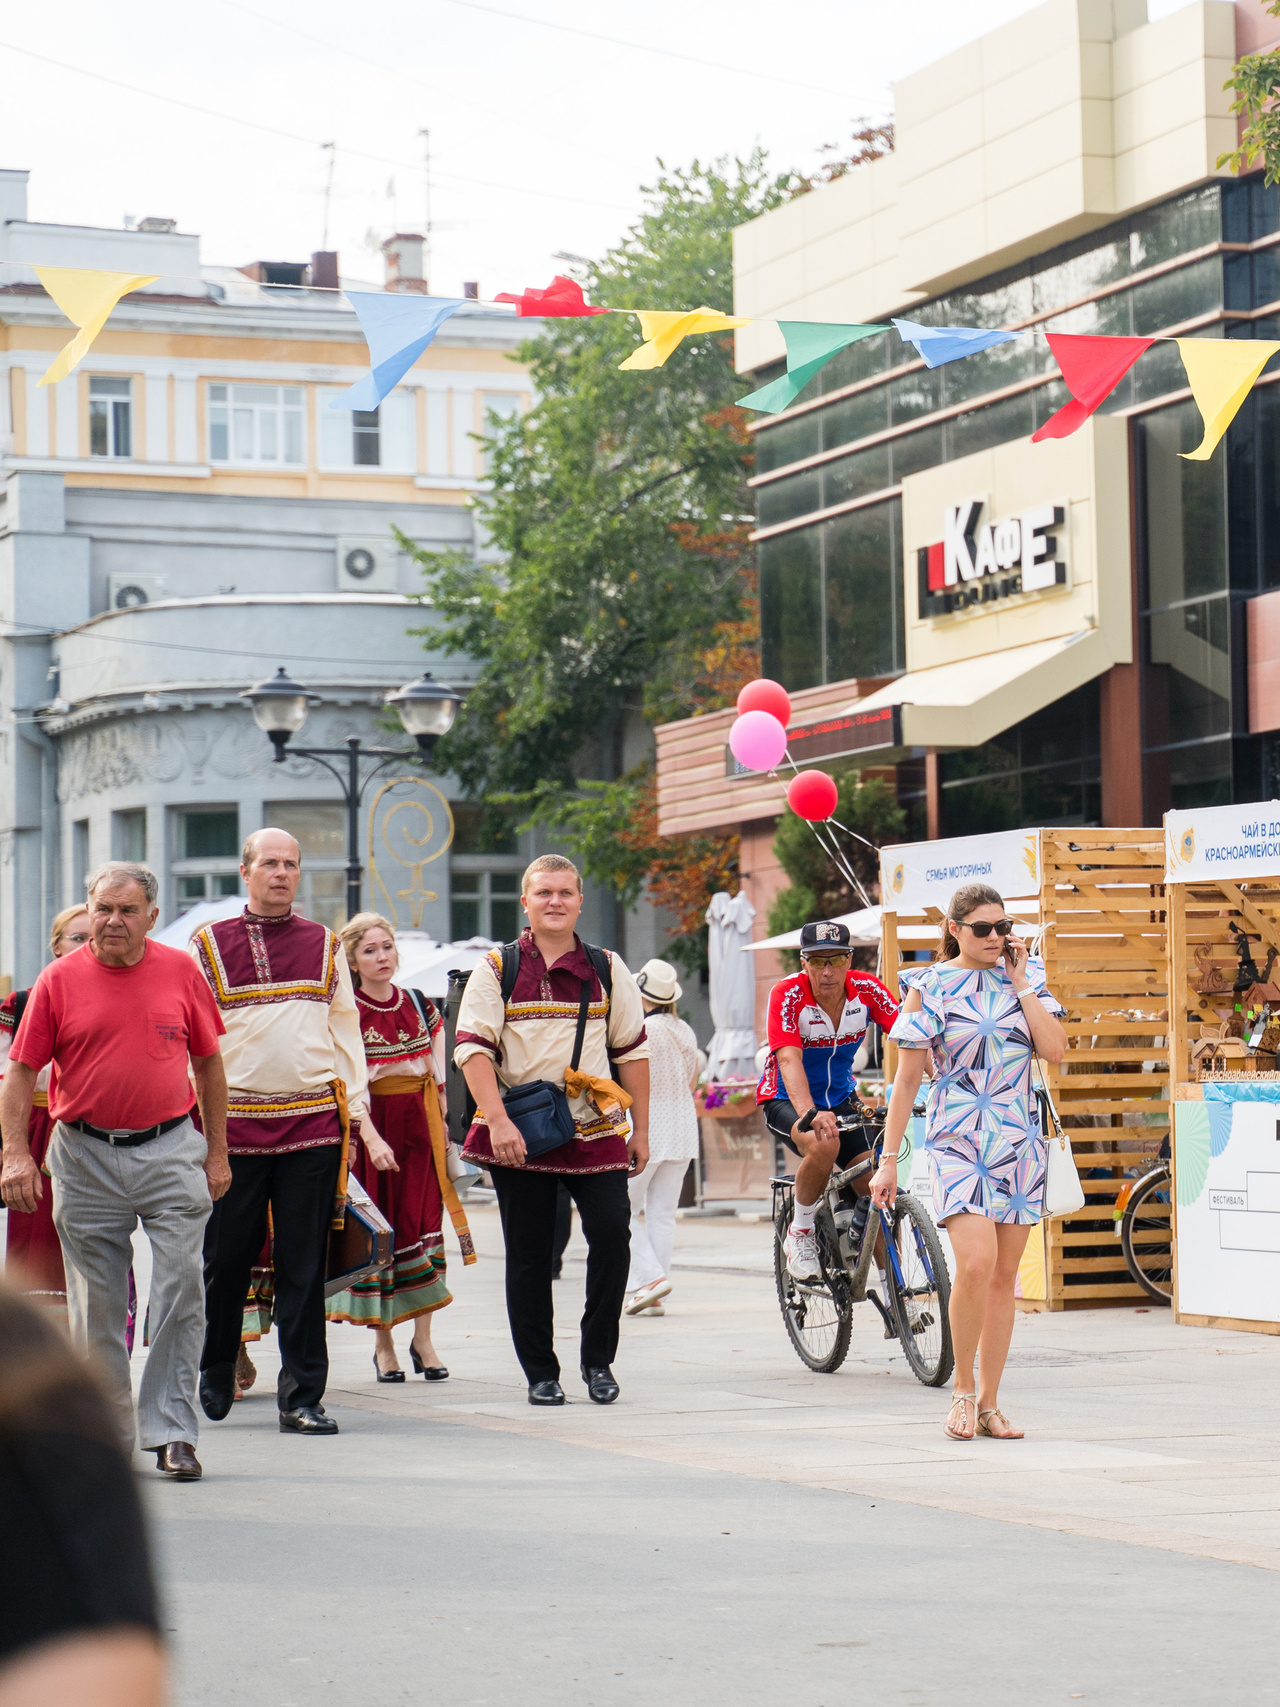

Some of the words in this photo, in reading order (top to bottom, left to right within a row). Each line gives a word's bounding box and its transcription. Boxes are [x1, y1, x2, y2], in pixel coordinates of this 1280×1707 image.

[1241, 821, 1257, 839] ЧАЙ
[1260, 823, 1266, 837] В
[925, 867, 948, 882] СЕМЬЯ
[948, 862, 993, 879] МОТОРИНЫХ
[1212, 1195, 1245, 1206] ФЕСТИВАЛЬ
